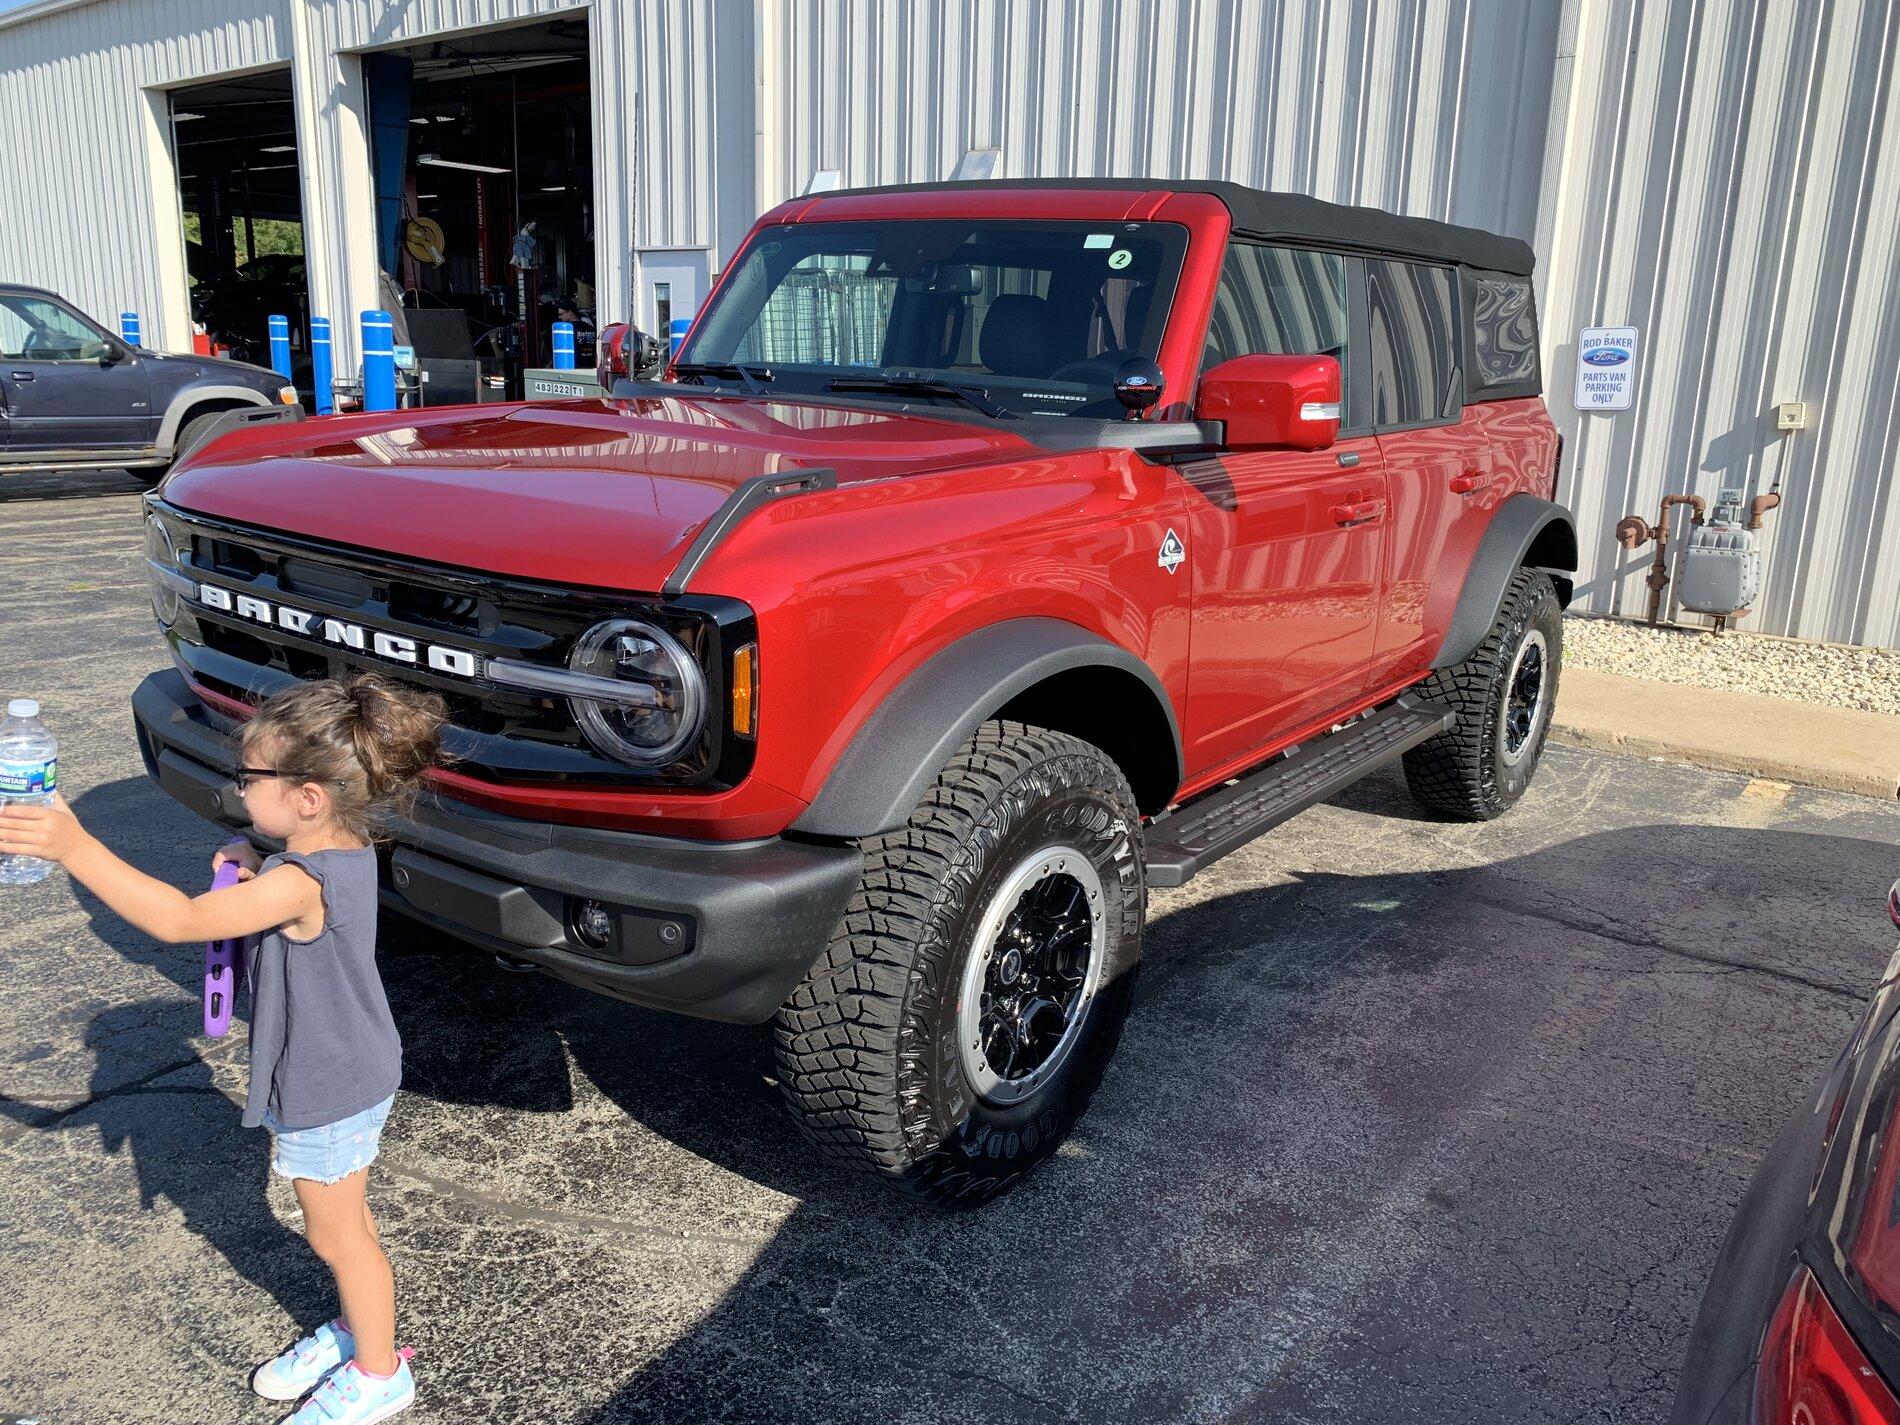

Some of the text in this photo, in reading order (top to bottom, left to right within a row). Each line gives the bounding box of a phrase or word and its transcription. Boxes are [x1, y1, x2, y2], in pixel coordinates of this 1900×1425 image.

[1115, 253, 1126, 265] 2
[1583, 338, 1633, 349] ROD BAKER
[1583, 372, 1626, 382] PARTS VAN
[535, 383, 583, 395] 483 222 T1
[1585, 382, 1622, 392] PARKING
[1592, 394, 1613, 402] ONLY
[200, 584, 475, 678] BRONCO
[1043, 802, 1139, 937] GOODYEAR
